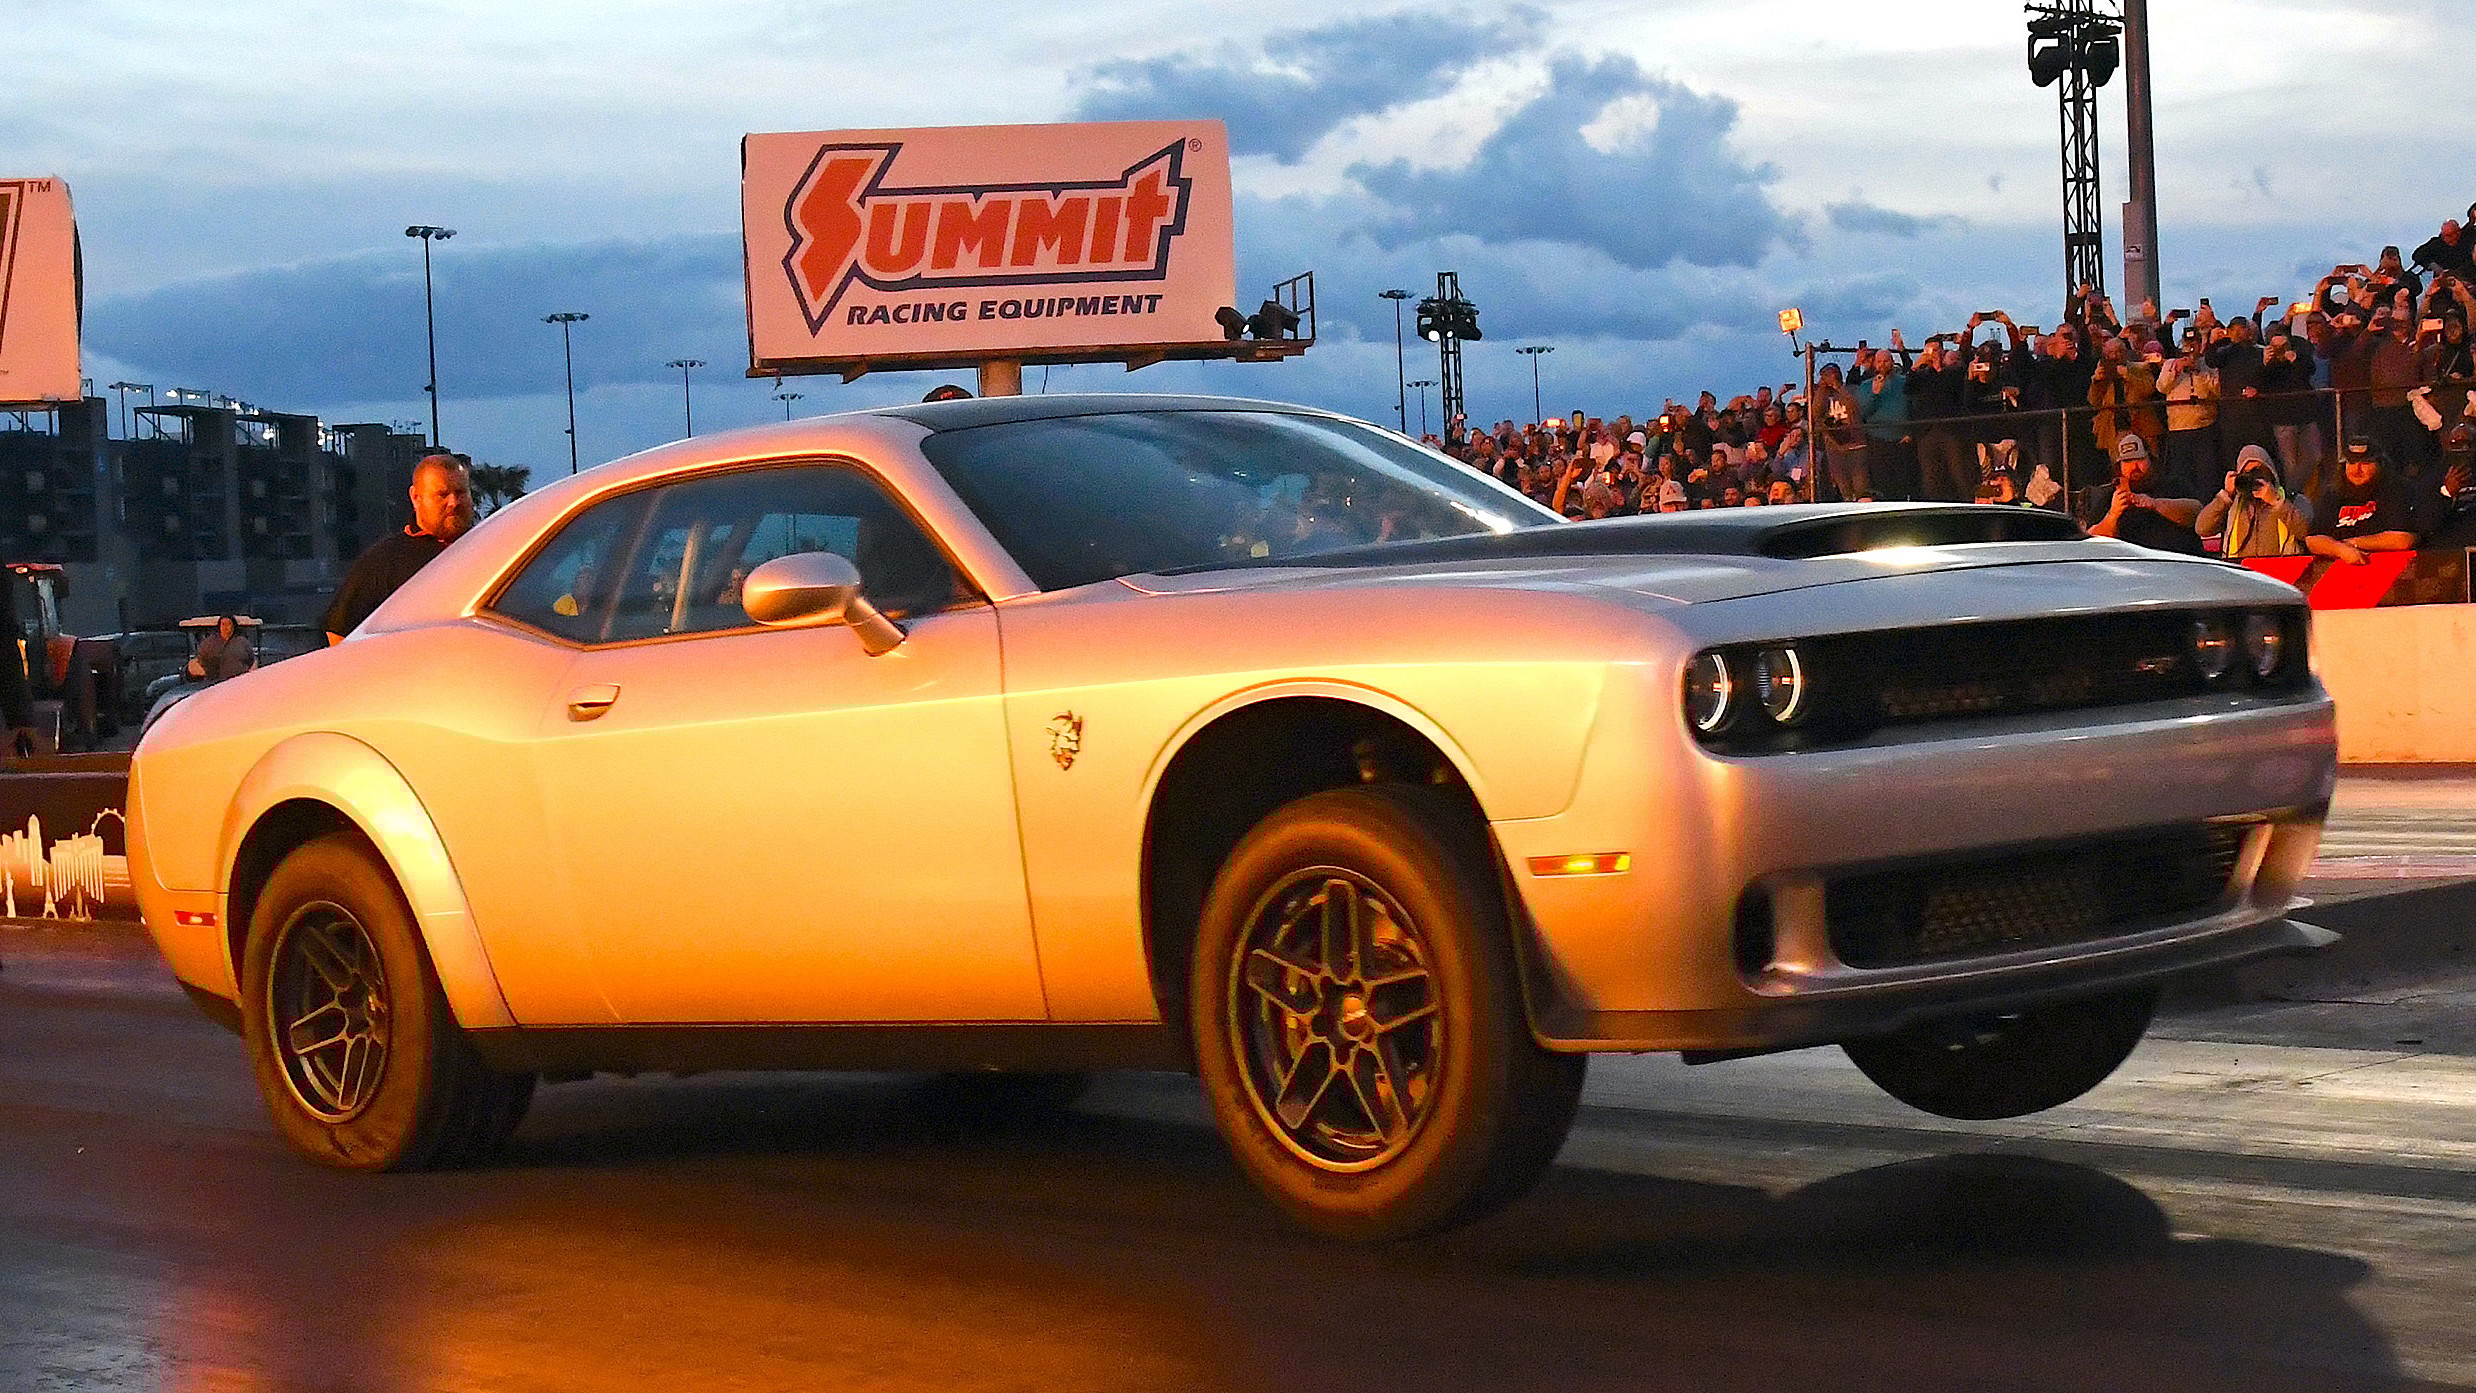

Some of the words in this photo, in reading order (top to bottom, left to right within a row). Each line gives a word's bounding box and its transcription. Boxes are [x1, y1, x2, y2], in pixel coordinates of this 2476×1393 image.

[27, 180, 51, 193] TM
[846, 300, 968, 326] RACING
[977, 293, 1164, 321] EQUIPMENT
